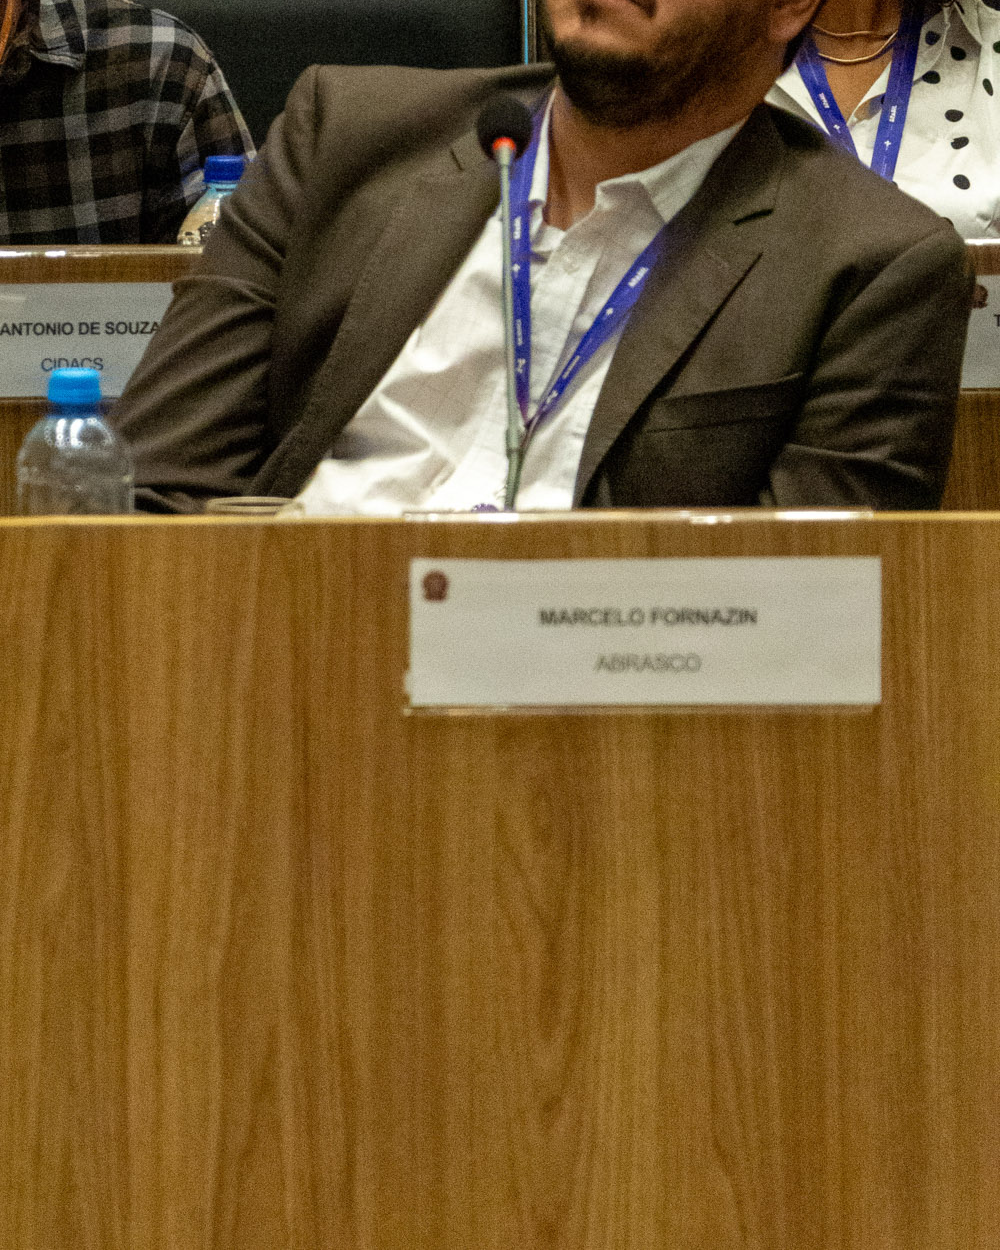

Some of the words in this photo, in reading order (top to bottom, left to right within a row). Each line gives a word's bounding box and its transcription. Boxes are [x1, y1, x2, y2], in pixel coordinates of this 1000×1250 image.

[0, 321, 74, 336] ANTONIO
[78, 321, 101, 336] DE
[104, 320, 160, 336] SOUZA
[41, 356, 104, 372] CIDACS
[540, 606, 645, 627] MARCELO
[650, 606, 758, 626] FORNAZIN
[594, 652, 702, 674] ABRASCO
